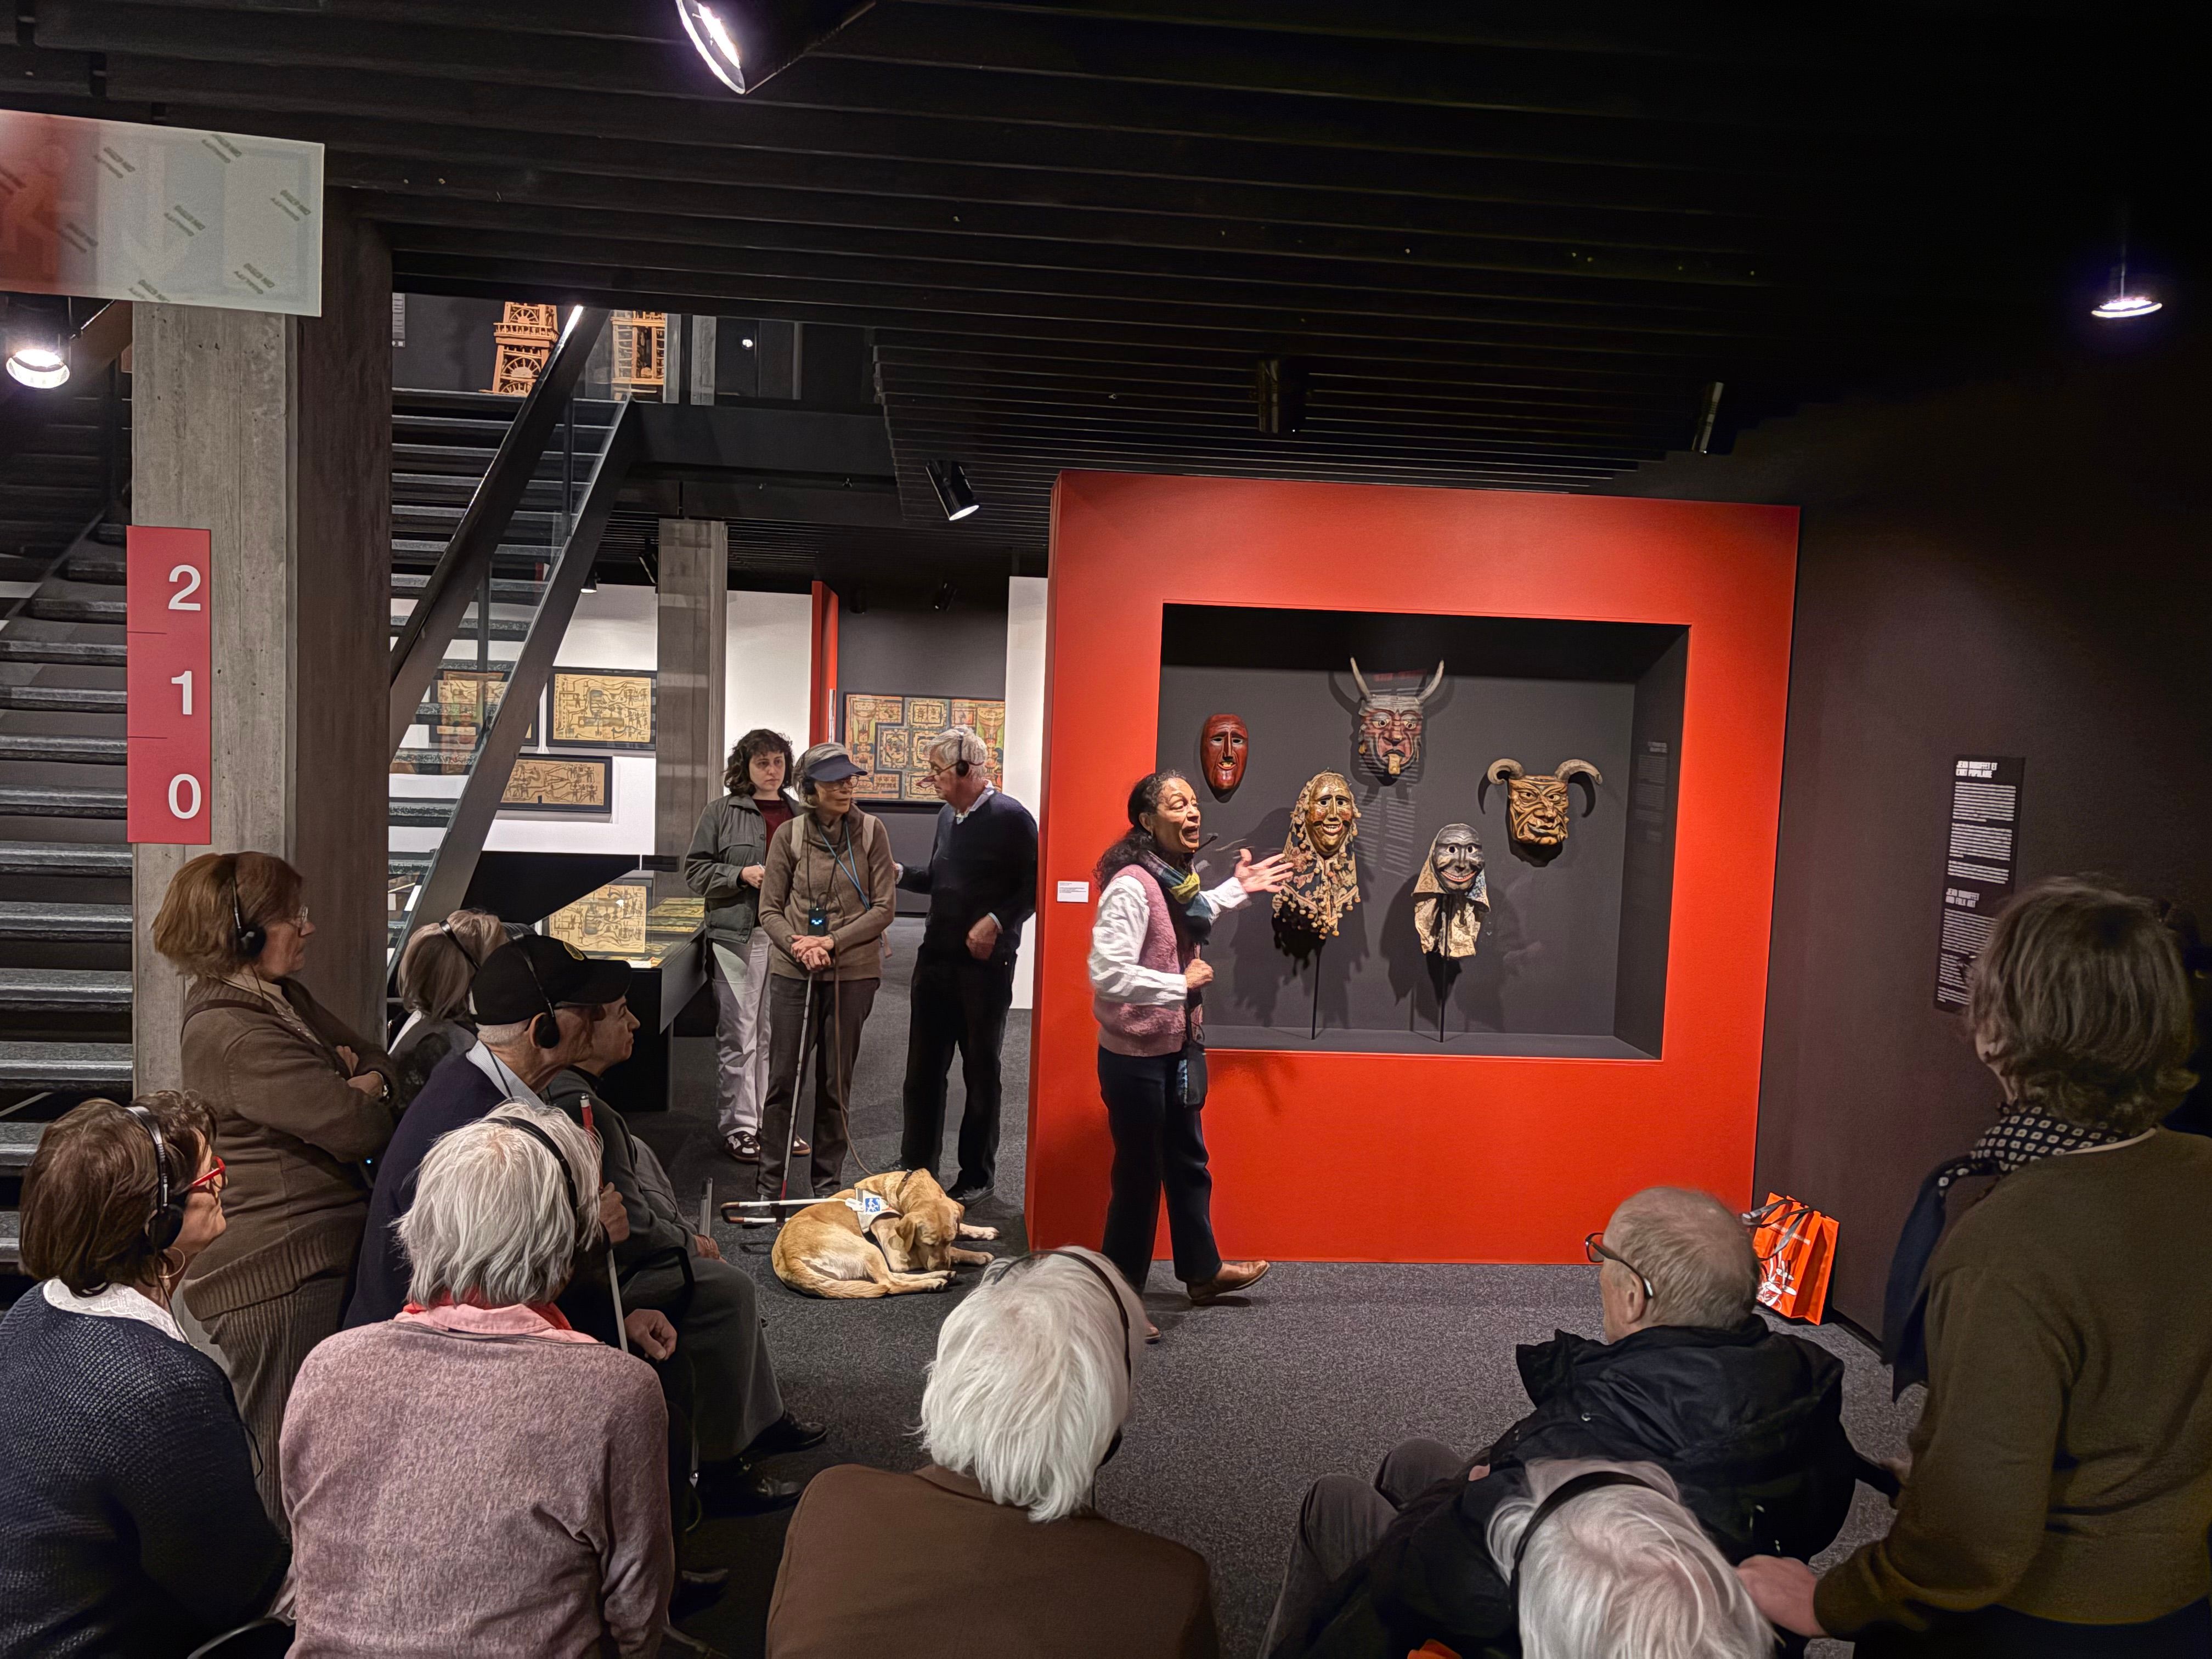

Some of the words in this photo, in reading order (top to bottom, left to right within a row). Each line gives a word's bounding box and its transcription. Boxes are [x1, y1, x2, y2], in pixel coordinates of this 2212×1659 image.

[168, 565, 201, 611] 2
[171, 670, 193, 715] 1
[168, 773, 202, 820] 0
